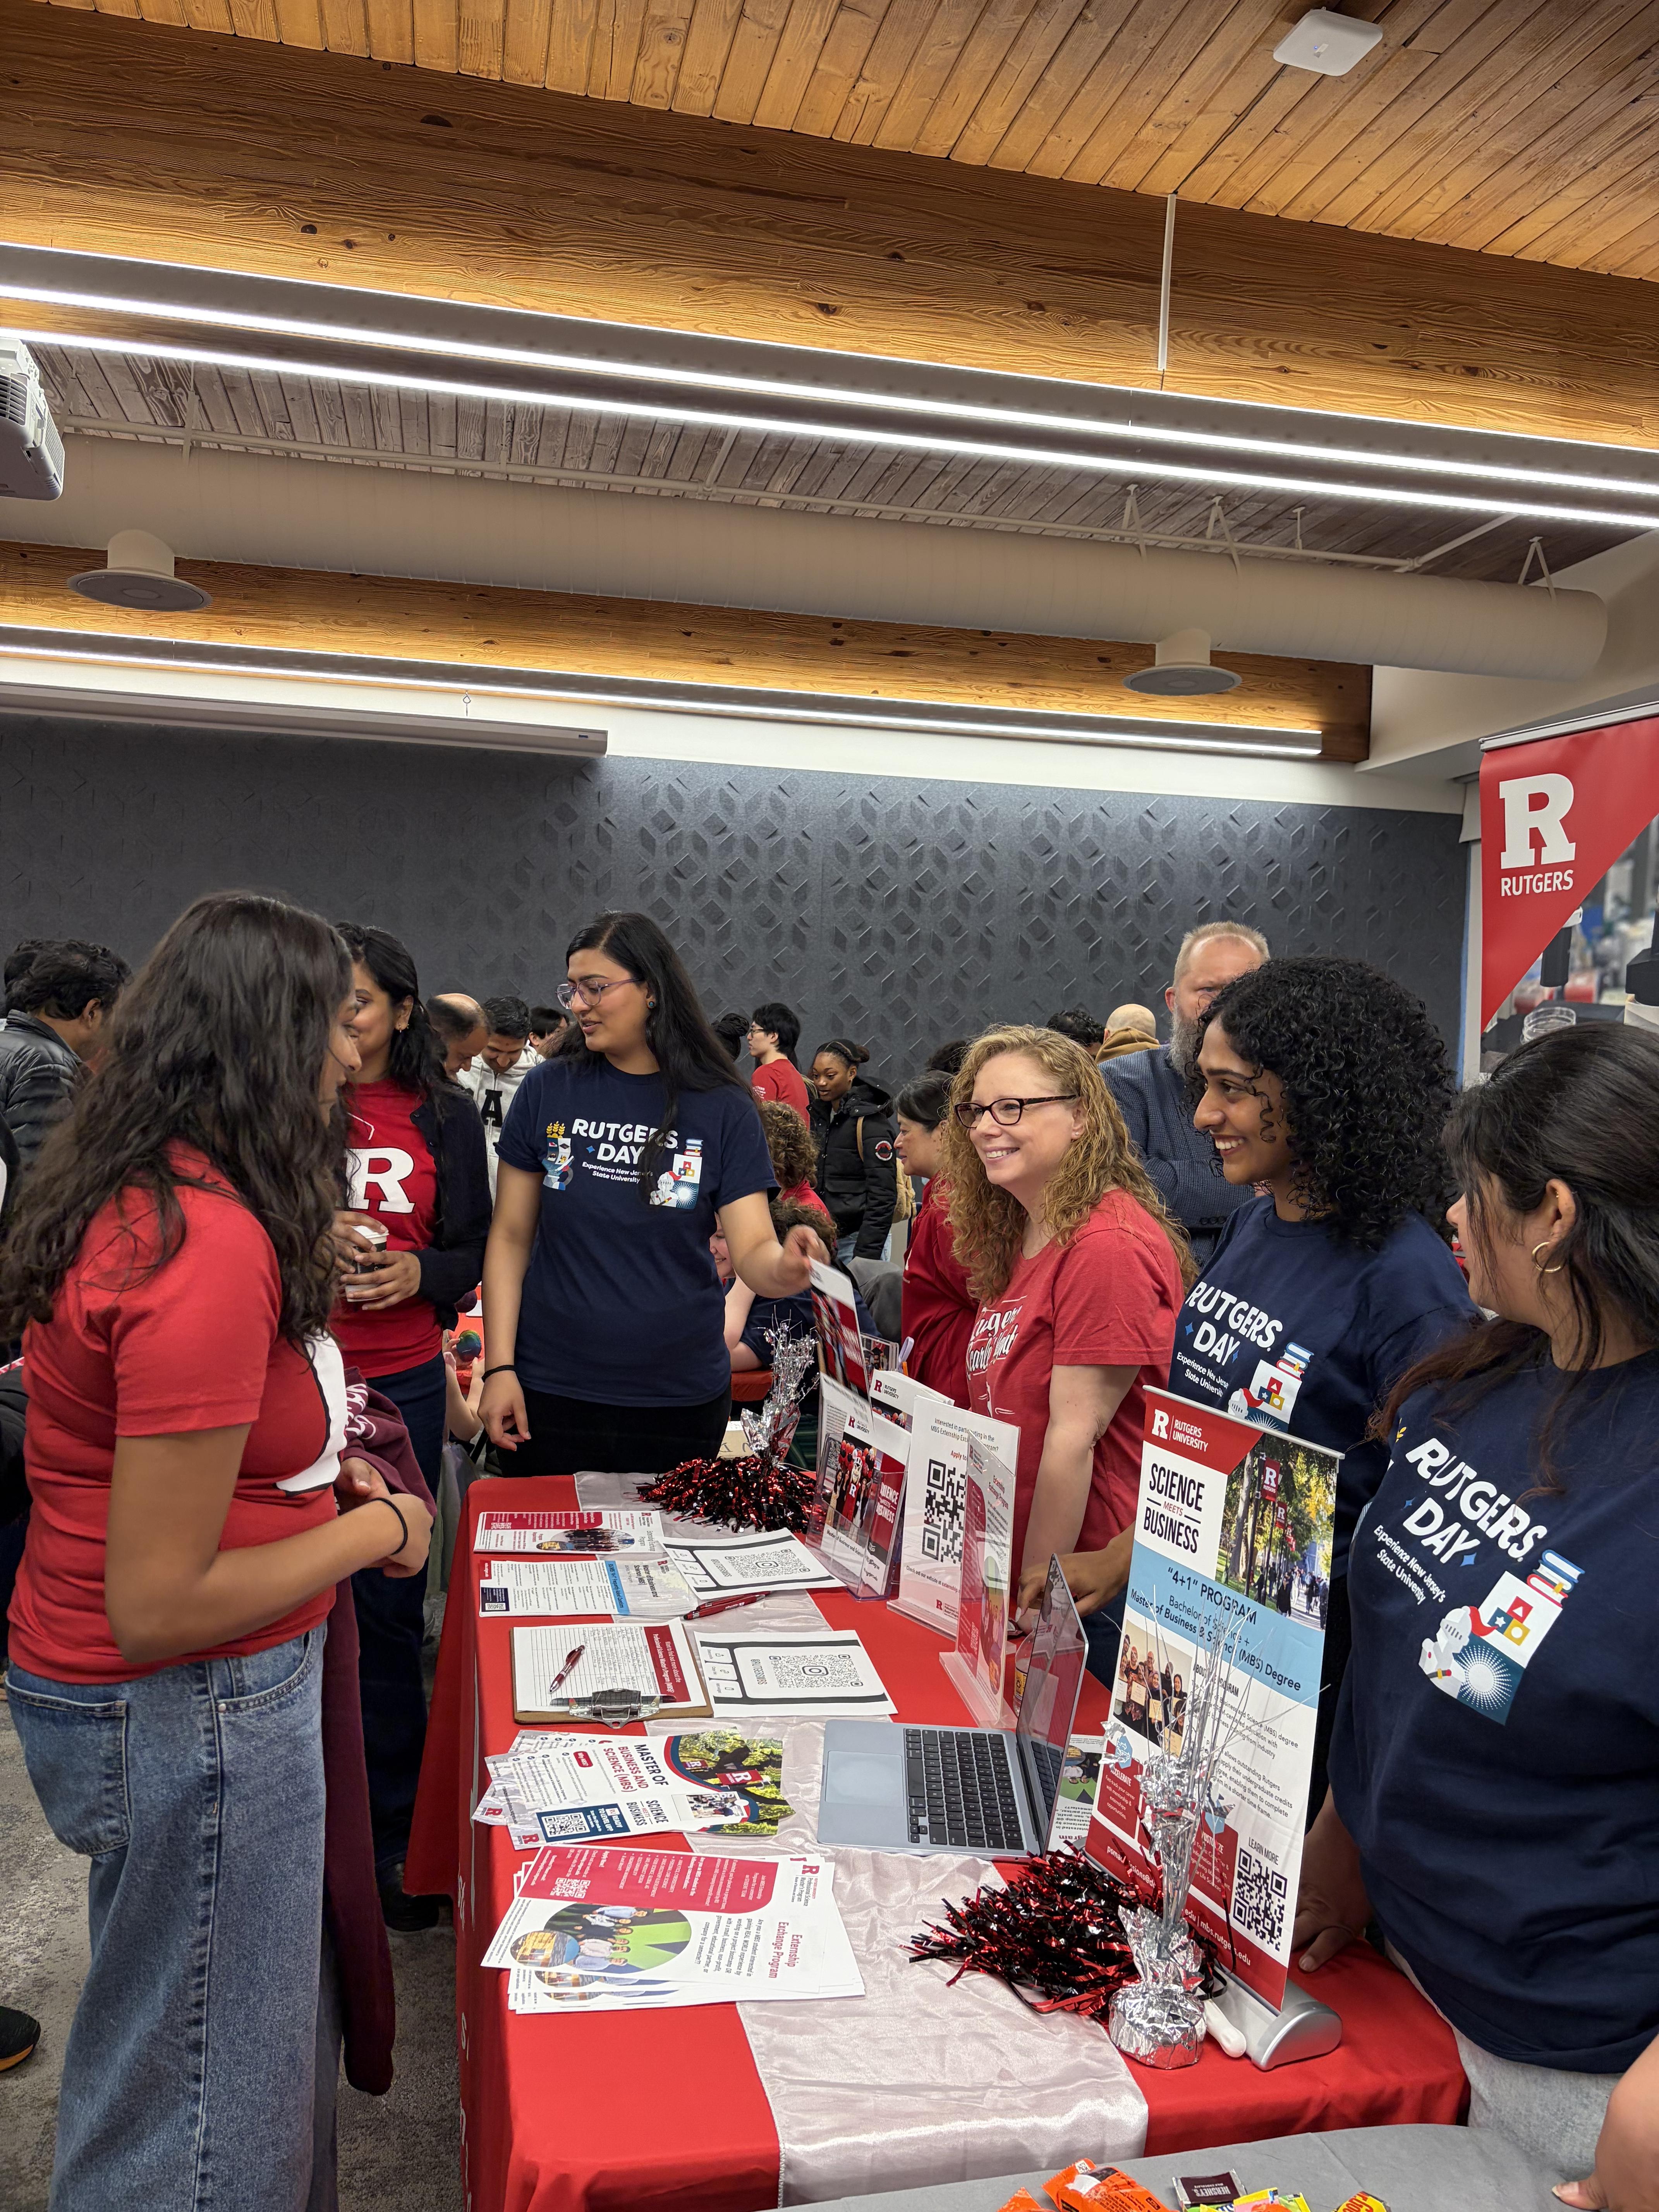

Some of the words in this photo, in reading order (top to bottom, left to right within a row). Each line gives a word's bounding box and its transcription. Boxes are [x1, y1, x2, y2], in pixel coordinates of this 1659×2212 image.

[1499, 773, 1576, 869] R
[1501, 869, 1574, 897] RUTGERS
[481, 1089, 502, 1127] A
[597, 1143, 645, 1164] DAY
[346, 1147, 415, 1213] R
[592, 1171, 610, 1180] State
[611, 1174, 640, 1184] University
[1185, 1281, 1283, 1348] RUTGERS
[1193, 1321, 1240, 1366] DAY
[1176, 1352, 1207, 1375] Experience
[874, 1379, 882, 1393] R
[935, 1418, 953, 1429] Interested
[940, 1428, 959, 1440] Externship
[1152, 1409, 1169, 1439] R
[1174, 1419, 1202, 1437] RUTGERS
[1172, 1431, 1208, 1451] UNIVERSITY
[951, 1450, 962, 1460] Apply
[1149, 1464, 1204, 1511] SCIENCE
[1264, 1467, 1276, 1487] R
[1163, 1501, 1183, 1516] MEETS
[1405, 1438, 1548, 1561] RUTGERS
[1278, 1506, 1285, 1520] R
[1144, 1507, 1198, 1553] BUSINESS
[1402, 1497, 1480, 1564] DAY
[633, 1565, 642, 1576] Science
[1373, 1525, 1410, 1564] Experience
[1408, 1560, 1426, 1580] New
[1424, 1573, 1446, 1603] Jersey's
[647, 1578, 656, 1591] Business
[1376, 1549, 1396, 1571] State
[1395, 1568, 1425, 1606] University
[936, 1599, 943, 1611] R
[1169, 1595, 1201, 1620] Bachelor
[1203, 1615, 1211, 1626] of
[1200, 1583, 1256, 1624] PROGRAM
[1130, 1589, 1152, 1610] Master
[1155, 1604, 1164, 1615] of
[1164, 1607, 1196, 1633] Business
[1238, 1649, 1263, 1672] (MBS)
[1265, 1663, 1300, 1692] Degree
[1245, 1725, 1266, 1742] education
[1267, 1739, 1278, 1748] with
[1247, 1714, 1263, 1728] Science
[1263, 1725, 1277, 1738] (MBS)
[1278, 1733, 1298, 1748] degree
[1246, 1735, 1256, 1747] from
[1257, 1742, 1275, 1759] industry
[603, 1748, 624, 1772] SCIENCE
[614, 1773, 637, 1792] (MBS)
[618, 1746, 641, 1774] BUSINESS
[633, 1775, 649, 1788] AND
[634, 1744, 661, 1774] MASTER
[652, 1775, 669, 1785] OF
[1224, 1750, 1237, 1762] allows
[1237, 1760, 1261, 1780] outstanding
[1262, 1774, 1280, 1791] Rutgers
[732, 1772, 752, 1782] R
[1232, 1765, 1242, 1776] their
[1242, 1774, 1273, 1798] undergraduate
[1274, 1795, 1292, 1808] credits
[1113, 1790, 1128, 1804] mentorship
[1126, 1791, 1135, 1800] career
[1217, 1766, 1228, 1779] gree,
[1229, 1776, 1247, 1792] enabling
[1247, 1787, 1258, 1799] them
[1264, 1800, 1288, 1817] complete
[1223, 1781, 1228, 1789] in
[1232, 1788, 1246, 1801] shorter
[1247, 1798, 1256, 1808] time
[1257, 1804, 1272, 1819] frame.
[485, 1807, 503, 1815] R
[600, 1813, 610, 1824] LEVEL
[605, 1823, 613, 1831] UP?
[612, 1815, 623, 1827] READY
[626, 1802, 647, 1826] BUSINESS
[641, 1807, 651, 1817] MEETS
[646, 1800, 668, 1823] SCIENCE
[522, 1834, 539, 1844] R
[1248, 1837, 1264, 1855] LEARN
[1264, 1848, 1279, 1865] MORE
[801, 1865, 819, 1874] R
[805, 1877, 813, 1895] Professional
[733, 1918, 742, 1931] working
[772, 1922, 789, 1950] Exchange
[708, 1935, 718, 1955] educational
[741, 1939, 749, 1952] WORLD
[785, 1934, 802, 1967] Externship
[737, 1952, 745, 1970] experience
[768, 1951, 783, 1978] Program
[1194, 2186, 1231, 2197] HERSHEY'S
